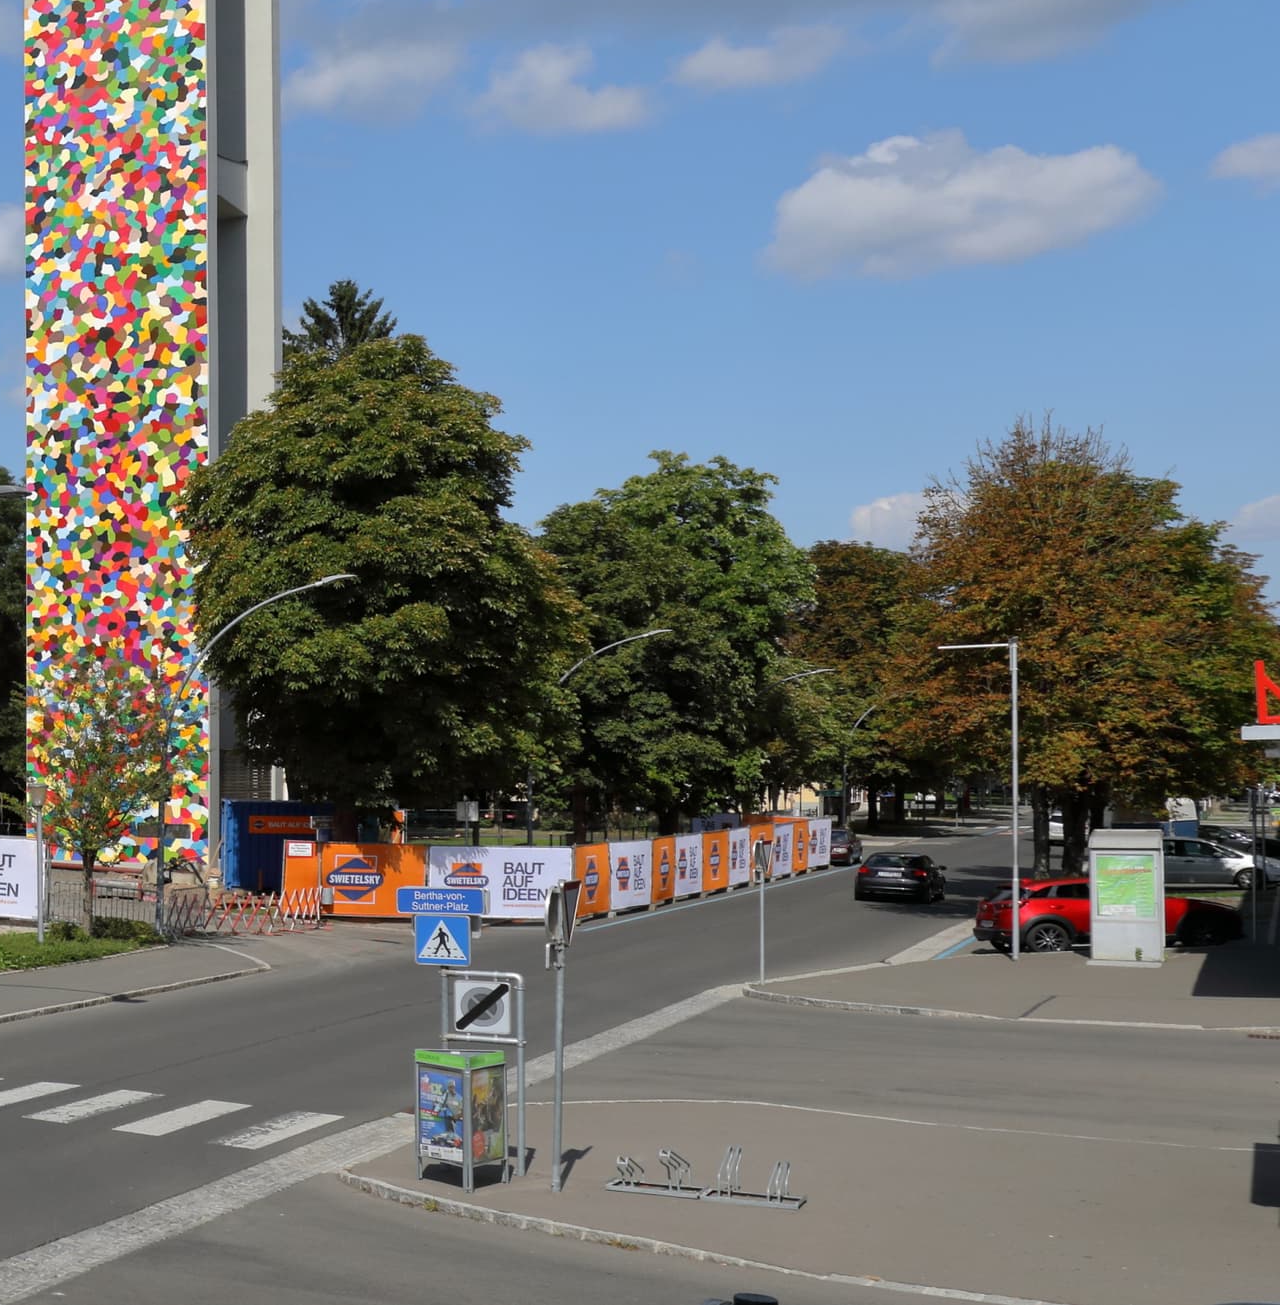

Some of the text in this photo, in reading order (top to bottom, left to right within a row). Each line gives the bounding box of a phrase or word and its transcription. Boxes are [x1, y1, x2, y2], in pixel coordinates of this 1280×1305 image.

[504, 862, 544, 875] BAUT
[329, 874, 381, 885] SWIETELSKY
[446, 876, 487, 886] SWIETELSKY
[502, 876, 534, 888] AUF
[414, 890, 466, 901] Bertha-von-
[502, 888, 548, 901] IDEEN
[411, 901, 469, 911] Suttner-Platz
